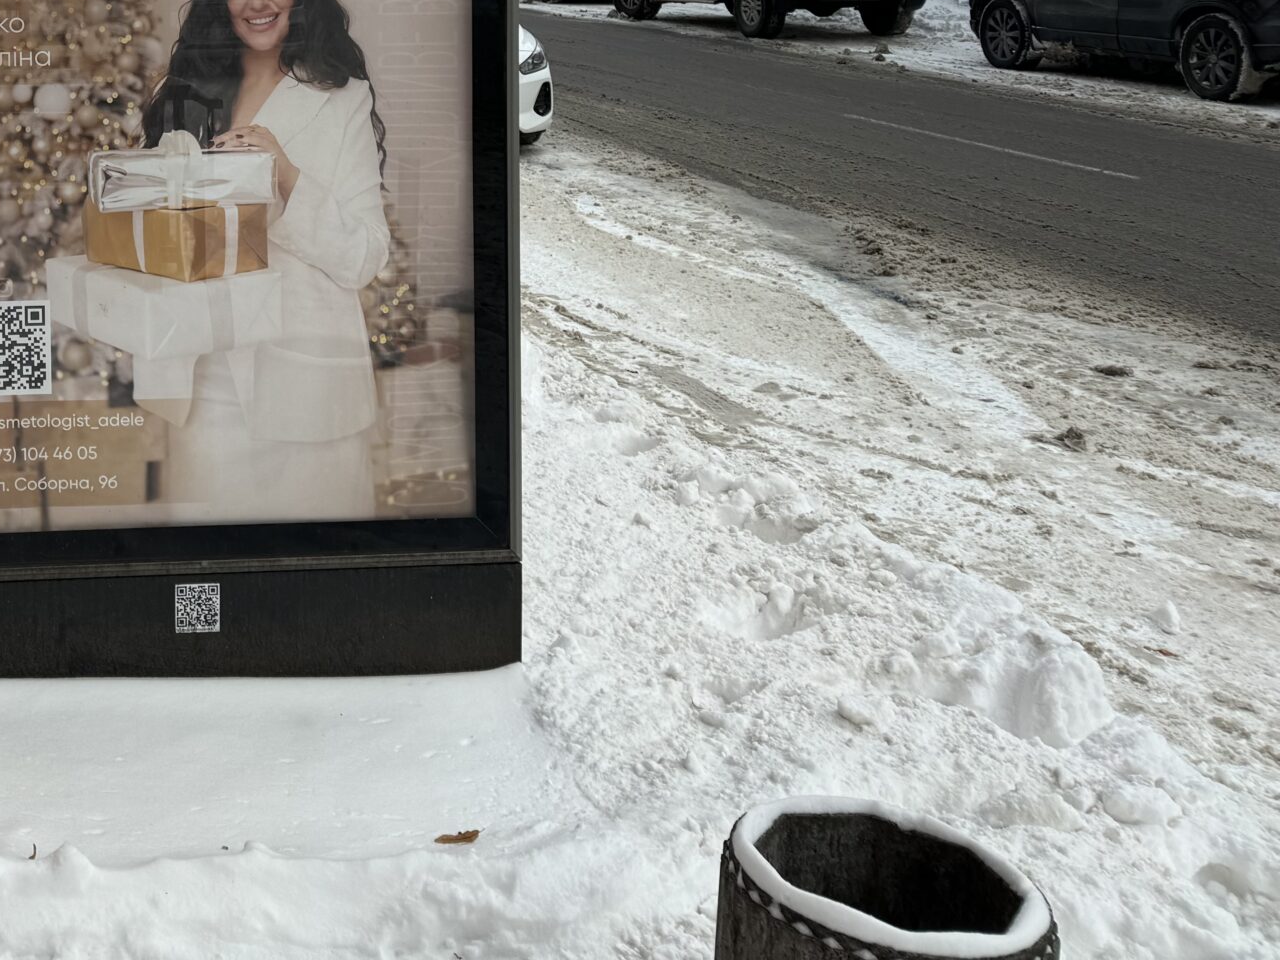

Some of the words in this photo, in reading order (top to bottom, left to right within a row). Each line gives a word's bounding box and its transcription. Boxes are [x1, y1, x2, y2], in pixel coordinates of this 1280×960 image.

[22, 447, 49, 461] 104
[53, 446, 73, 461] 46
[77, 446, 98, 460] 05
[14, 476, 94, 493] Соборна,
